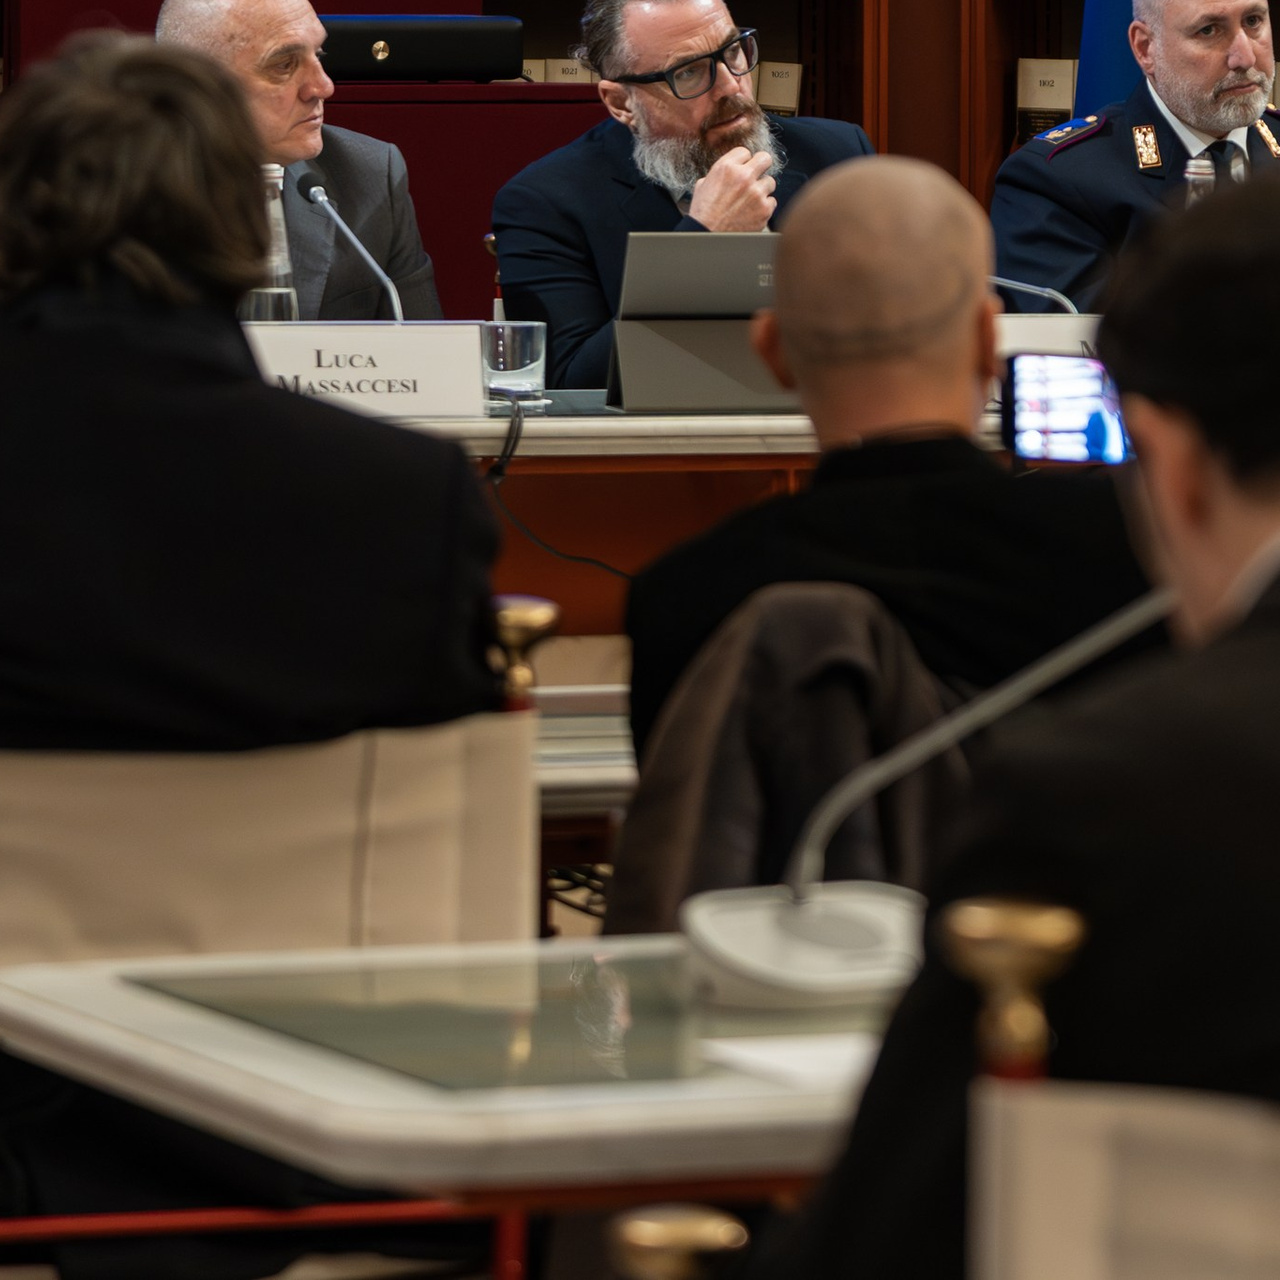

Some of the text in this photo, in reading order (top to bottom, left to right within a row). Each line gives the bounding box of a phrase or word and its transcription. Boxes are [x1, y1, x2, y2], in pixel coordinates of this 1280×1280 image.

[562, 68, 578, 76] 1021
[772, 71, 790, 79] 1025
[1040, 80, 1055, 88] 1102
